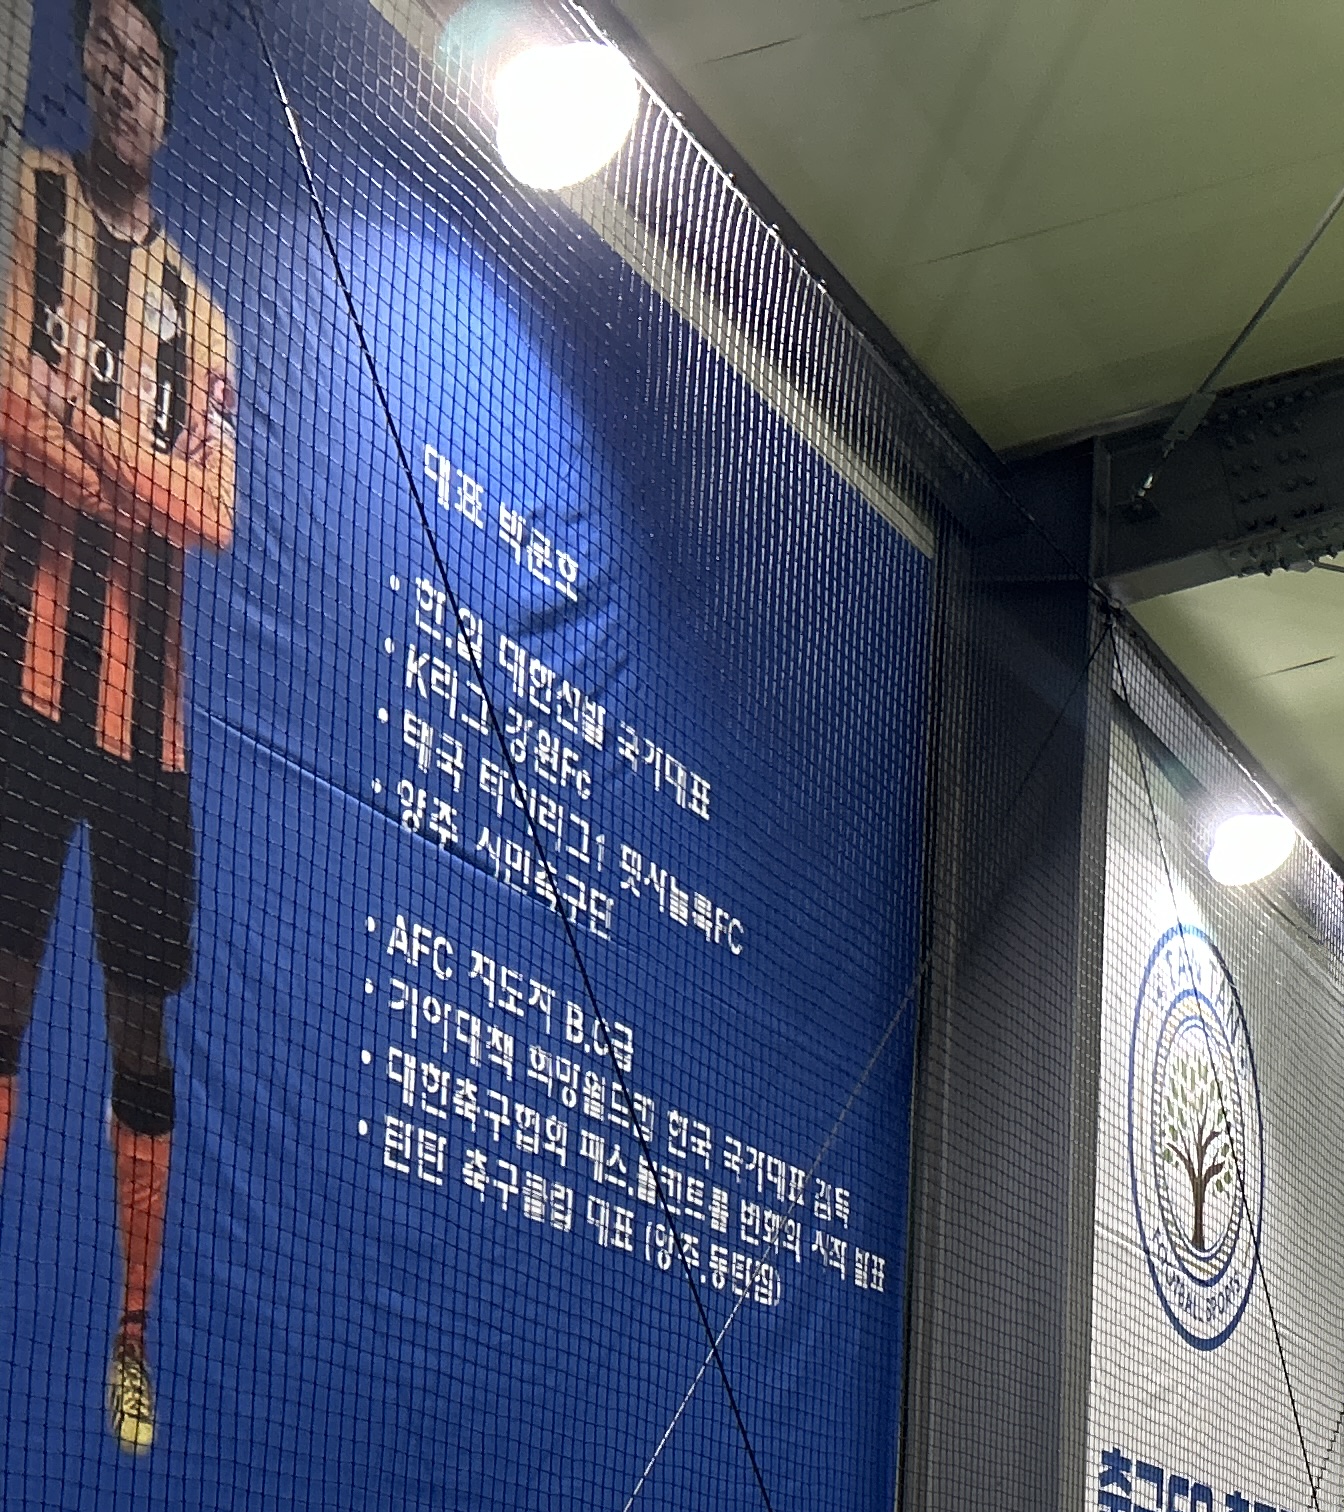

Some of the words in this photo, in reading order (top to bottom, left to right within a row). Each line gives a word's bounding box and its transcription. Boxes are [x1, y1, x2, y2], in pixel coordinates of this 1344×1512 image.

[424, 443, 484, 530] 대표
[405, 643, 489, 736] K리그
[415, 577, 483, 670] 한.일
[617, 719, 711, 820] 국가대표
[402, 708, 464, 793] 태국
[397, 779, 459, 850] 양주
[387, 914, 454, 980] AFC
[468, 949, 556, 1035] 지도자
[384, 1113, 448, 1186] 탄탄
[462, 1148, 575, 1234] 축구클럽
[586, 1194, 635, 1252] 대표
[387, 1046, 568, 1167] 대한축구협회
[811, 1230, 848, 1281] 시작
[527, 1045, 655, 1142] 희망월드컵
[667, 1109, 712, 1170] 한국
[723, 1135, 806, 1206] 국가대표
